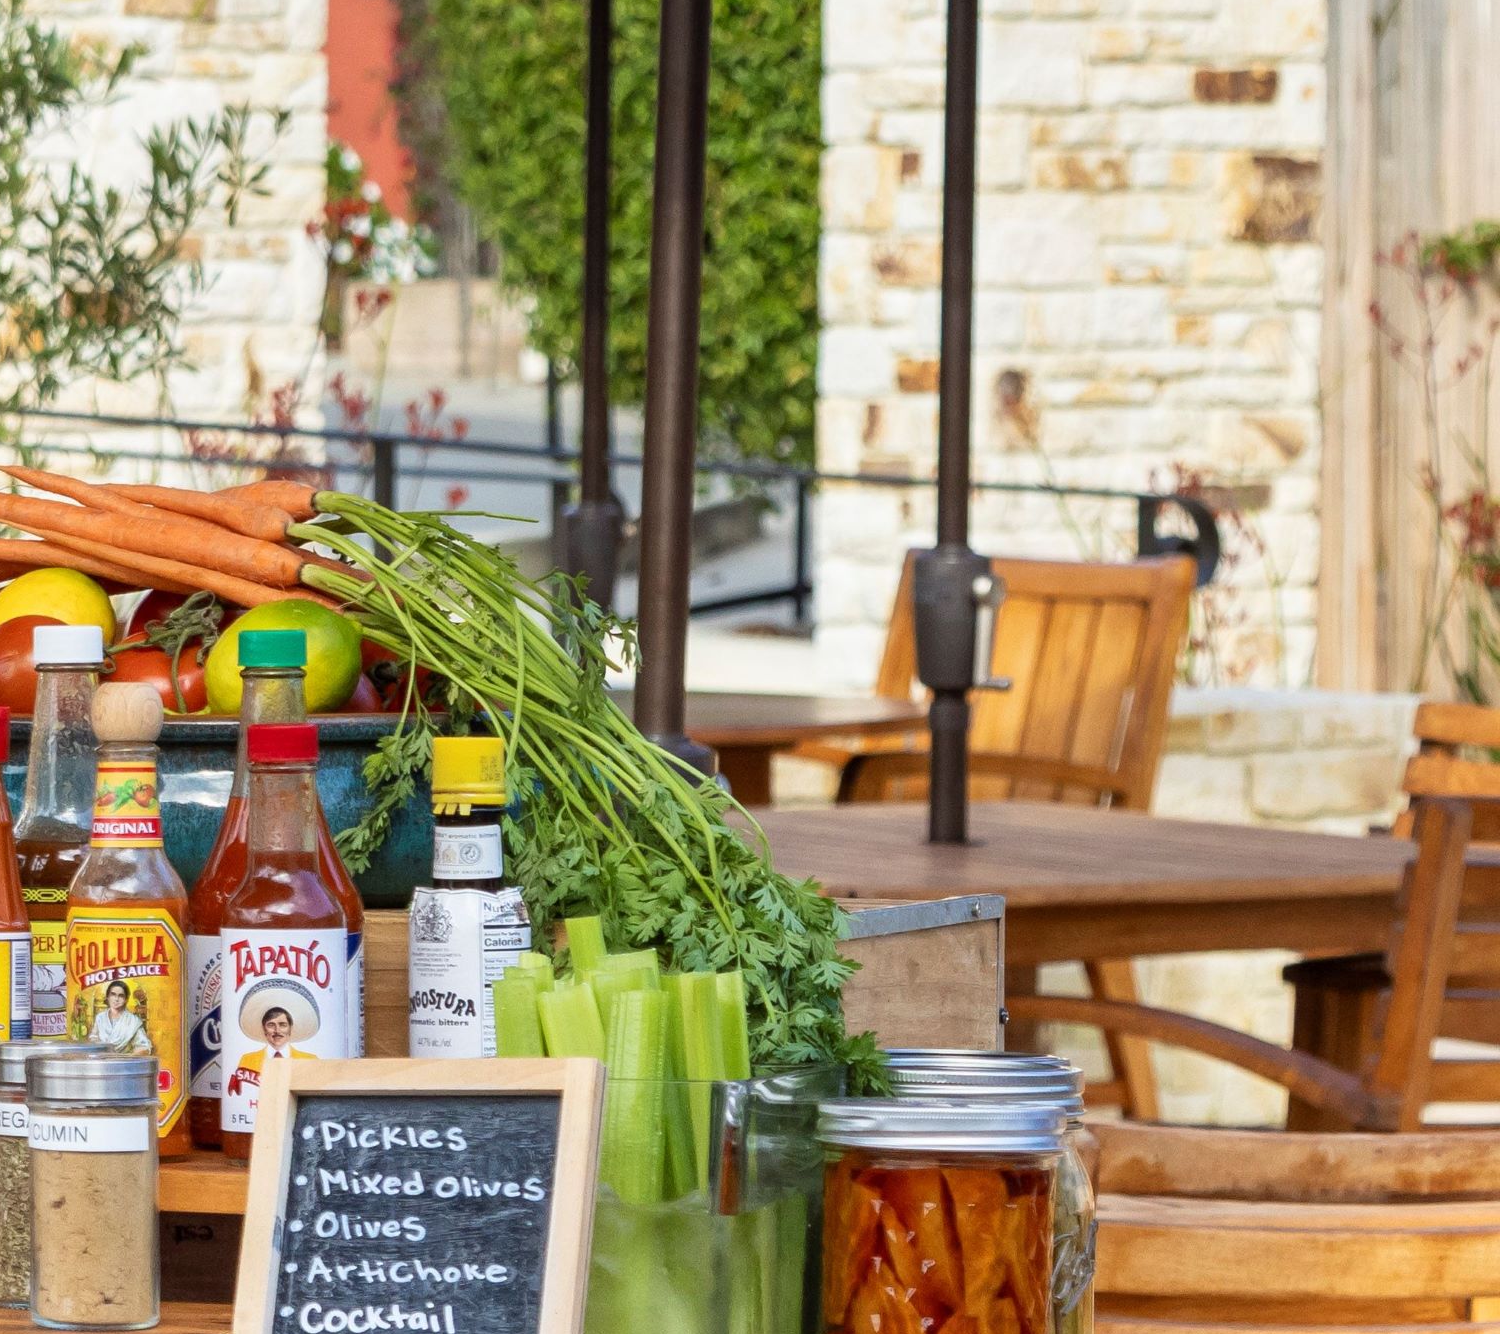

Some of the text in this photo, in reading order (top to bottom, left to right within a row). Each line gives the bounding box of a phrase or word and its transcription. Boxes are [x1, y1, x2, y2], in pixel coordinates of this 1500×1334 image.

[93, 821, 156, 835] ORIGINAL
[69, 936, 169, 976] CHOLULA
[230, 939, 330, 992] TAPATÍO
[85, 965, 162, 986] HOT SAUCE
[197, 957, 215, 991] YEARS
[202, 969, 222, 1011] LOUISIA
[410, 988, 477, 1017] NGOSTURA
[439, 1018, 469, 1027] bitters
[237, 1070, 261, 1085] SALS
[33, 1123, 89, 1143] CUMIN
[231, 1114, 253, 1125] 5 FL.
[321, 1120, 467, 1151] Pickles
[319, 1168, 546, 1201] Mixed Olives
[315, 1212, 426, 1241] Olives
[300, 1302, 456, 1334] Cocktail
